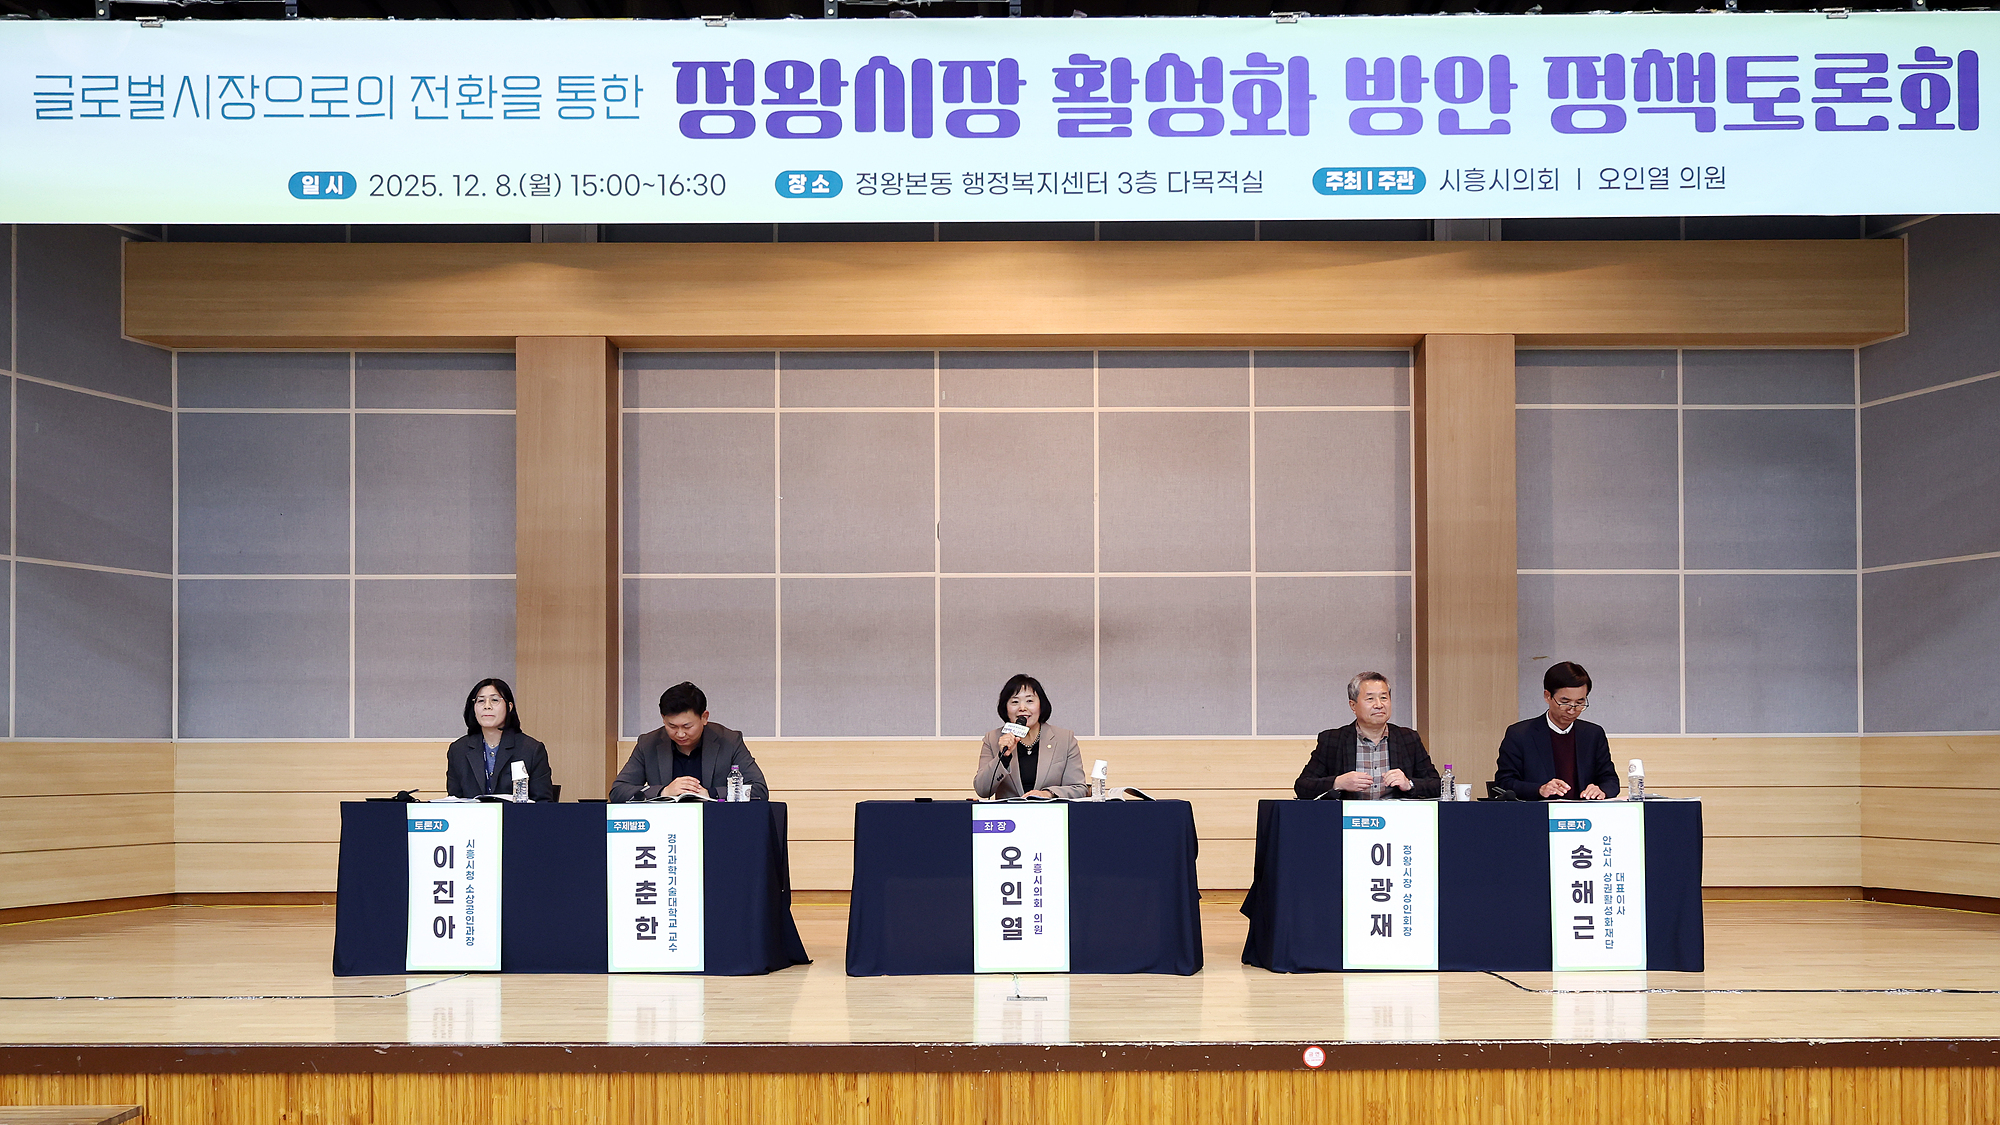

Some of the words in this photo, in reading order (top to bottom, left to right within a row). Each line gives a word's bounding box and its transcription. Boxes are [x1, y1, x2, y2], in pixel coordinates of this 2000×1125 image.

[34, 73, 394, 121] 글로벌시장으로의
[411, 73, 543, 120] 전환을
[556, 73, 644, 120] 통한
[671, 55, 1028, 140] 정왕시장
[1051, 51, 1318, 139] 활성화
[1345, 53, 1519, 137] 방안
[1542, 45, 1980, 135] 정책토론회
[369, 174, 443, 198] 2025.
[452, 174, 486, 198] 12.
[570, 173, 726, 198] 15:00~16:30
[856, 171, 953, 196] 정왕본동
[961, 171, 1108, 196] 행정복지센터
[1117, 171, 1158, 196] 3층
[1168, 170, 1263, 195] 다목적실
[1439, 167, 1559, 192] 시흥시의회
[1598, 166, 1670, 191] 오인열
[1679, 166, 1726, 191] 의원
[415, 821, 443, 831] 토론자
[613, 821, 647, 831] 주제발표
[1351, 817, 1380, 828] 토론자
[1557, 820, 1586, 830] 토론자
[465, 839, 475, 881] 시흥시청
[1402, 844, 1413, 889] 정왕시장
[1602, 835, 1613, 868] 안산시
[432, 845, 456, 940] 이진아
[634, 846, 659, 941] 조춘한
[667, 833, 678, 928] 경기과학기술대학교
[1000, 846, 1023, 941] 오인열
[1033, 852, 1043, 908] 시흥시의회
[1370, 842, 1394, 938] 이광재
[1570, 844, 1595, 940] 송해근
[1615, 872, 1626, 916] 대표이사
[465, 884, 475, 947] 소상공인과장
[1033, 913, 1043, 935] 의원
[1402, 893, 1413, 937] 상인회장
[1603, 872, 1614, 950] 상권활성화재단
[668, 931, 678, 953] 교수
